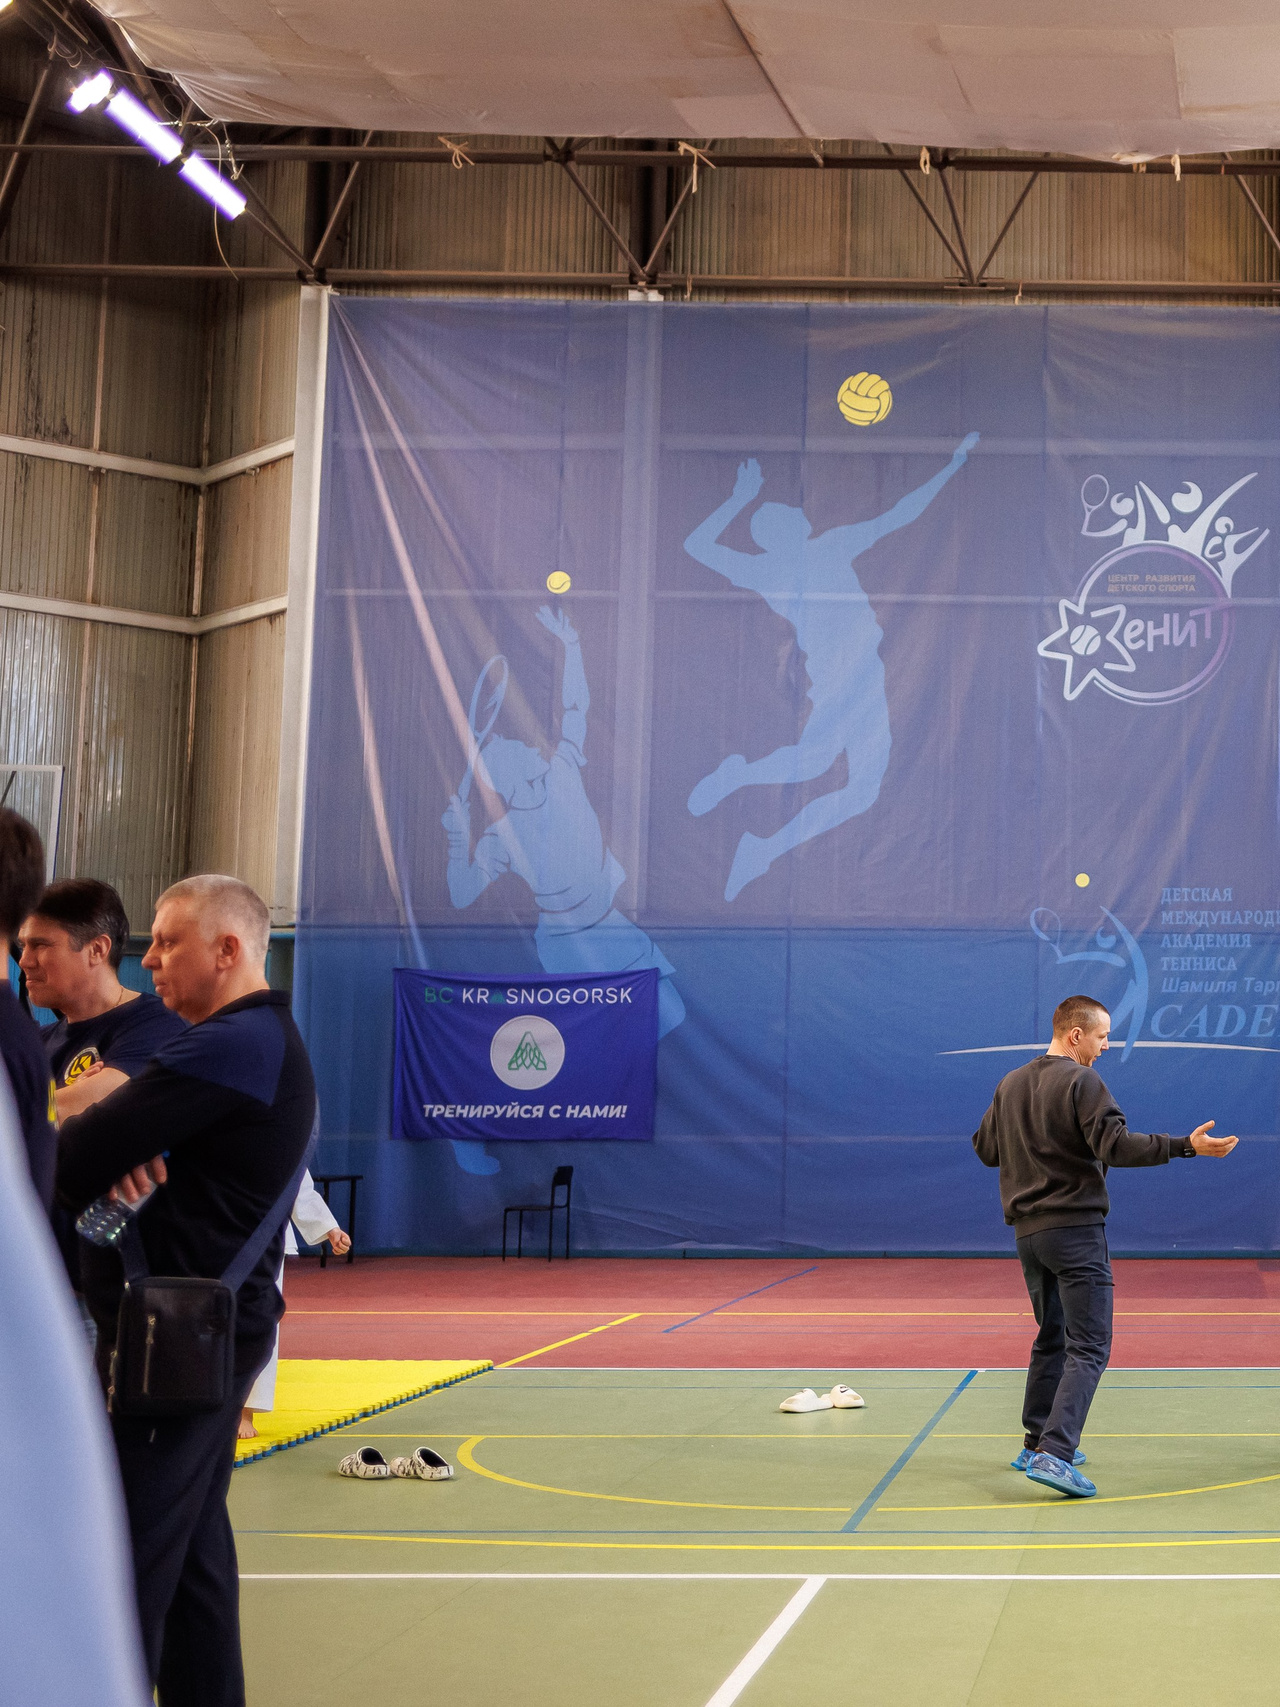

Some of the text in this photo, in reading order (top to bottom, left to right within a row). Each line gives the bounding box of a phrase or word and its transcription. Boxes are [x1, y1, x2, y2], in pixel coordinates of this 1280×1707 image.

[1108, 575, 1196, 583] ЦЕНТР РАЗВИТИЯ
[1107, 583, 1196, 593] ДЕТСКОГО СПОРТА
[1161, 887, 1234, 905] ДЕТСКАЯ
[1160, 933, 1252, 950] АКАДЕМИЯ
[1161, 956, 1238, 972] ТЕННИСА
[1161, 978, 1238, 994] Шамиля
[423, 1102, 628, 1119] ТРЕНИРУЙСЯ С НАМИ!
